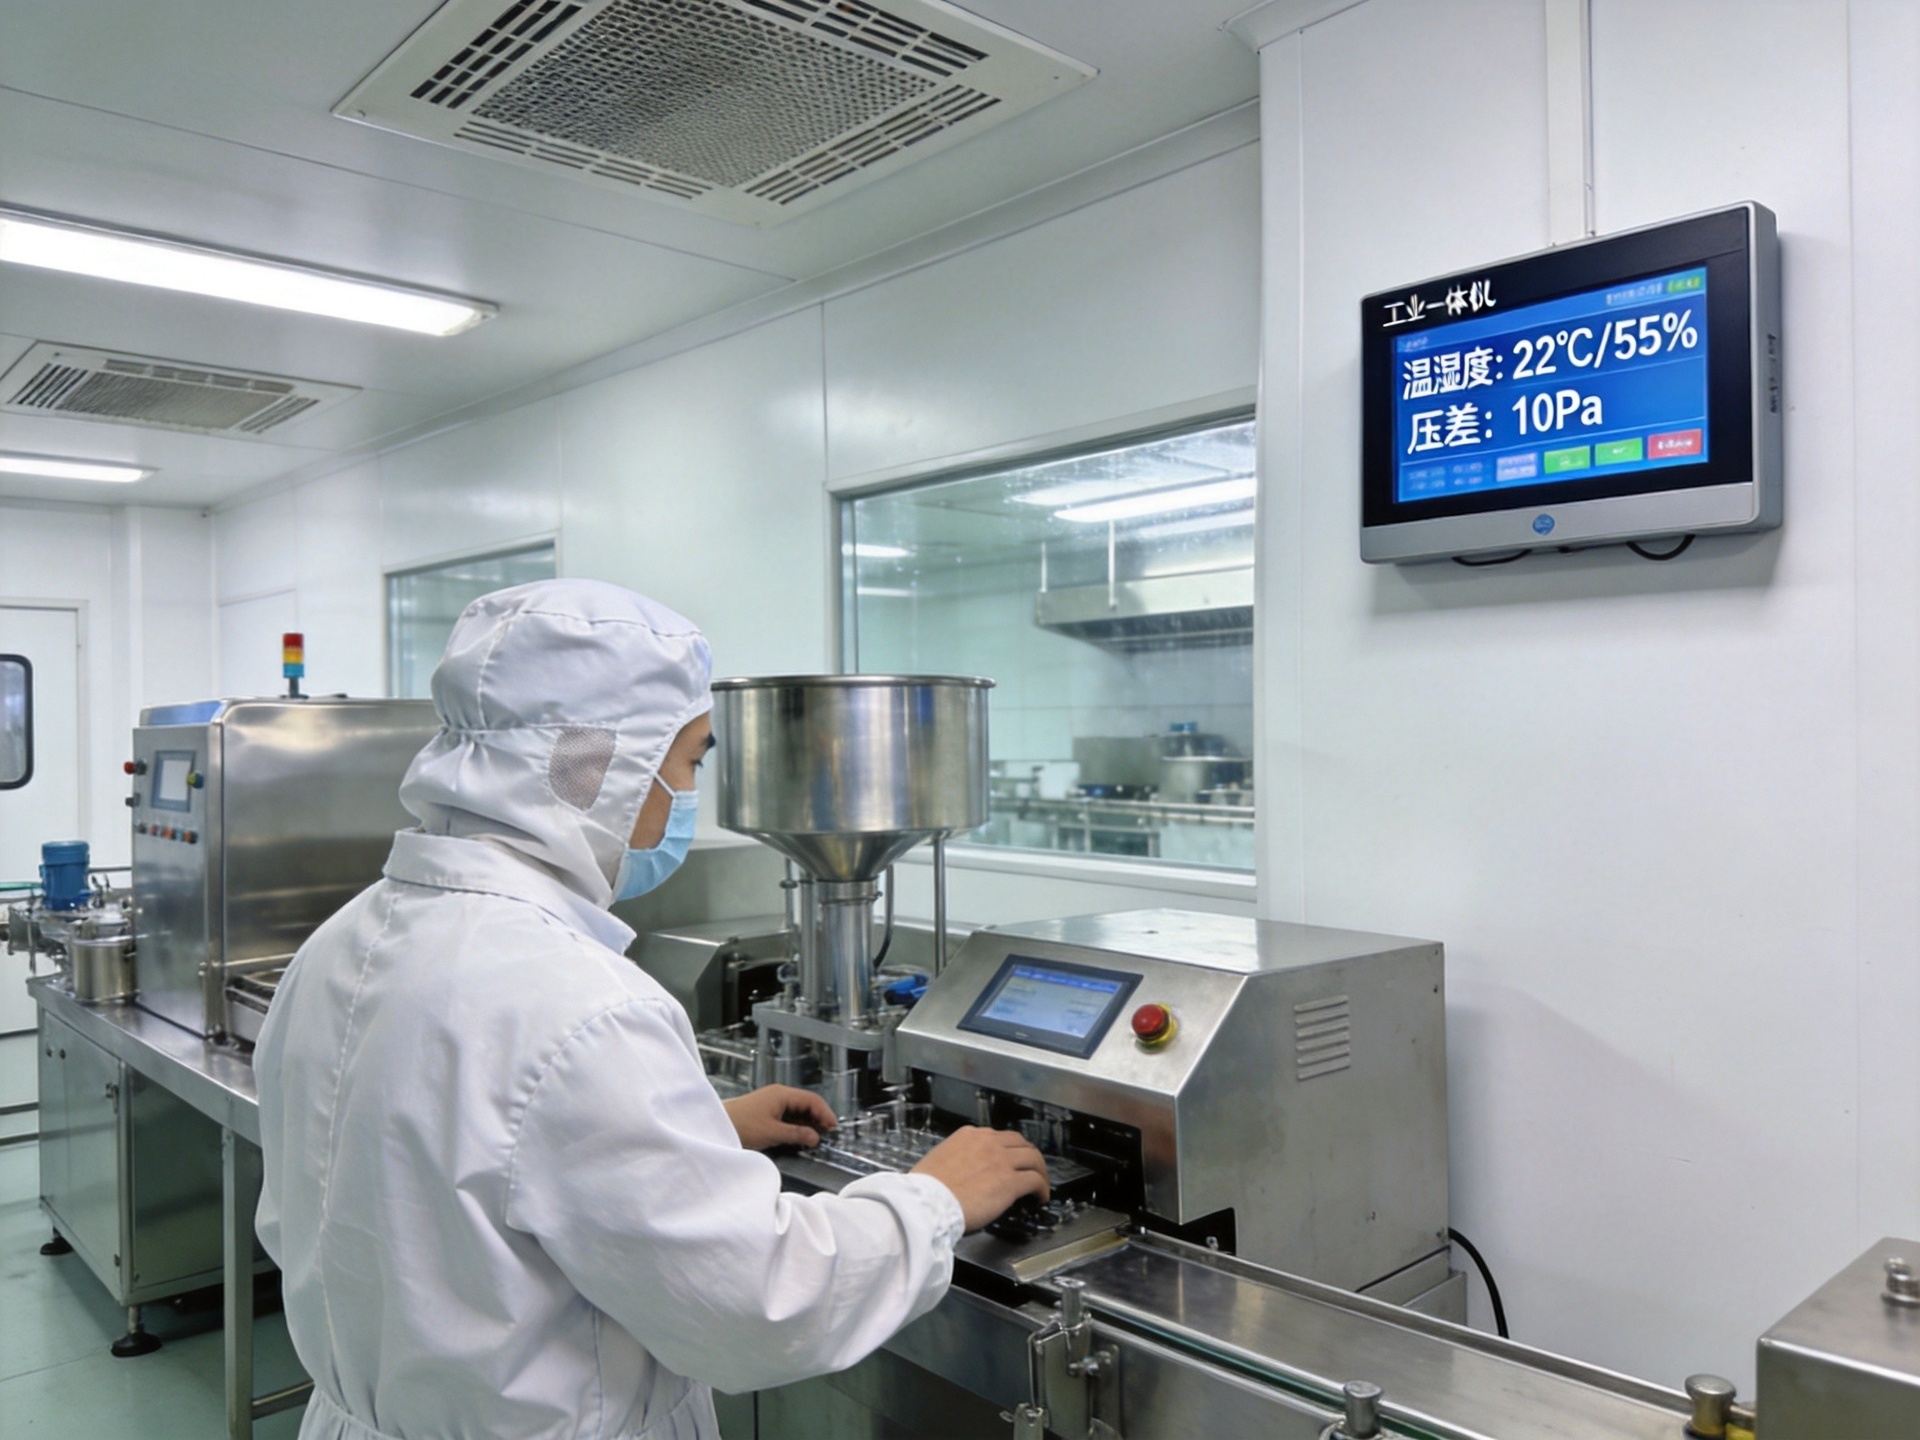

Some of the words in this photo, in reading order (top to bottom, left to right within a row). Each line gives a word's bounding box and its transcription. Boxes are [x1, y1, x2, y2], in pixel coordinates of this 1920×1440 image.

[1382, 279, 1497, 328] 工业一体机
[1511, 389, 1603, 436] 10Pa
